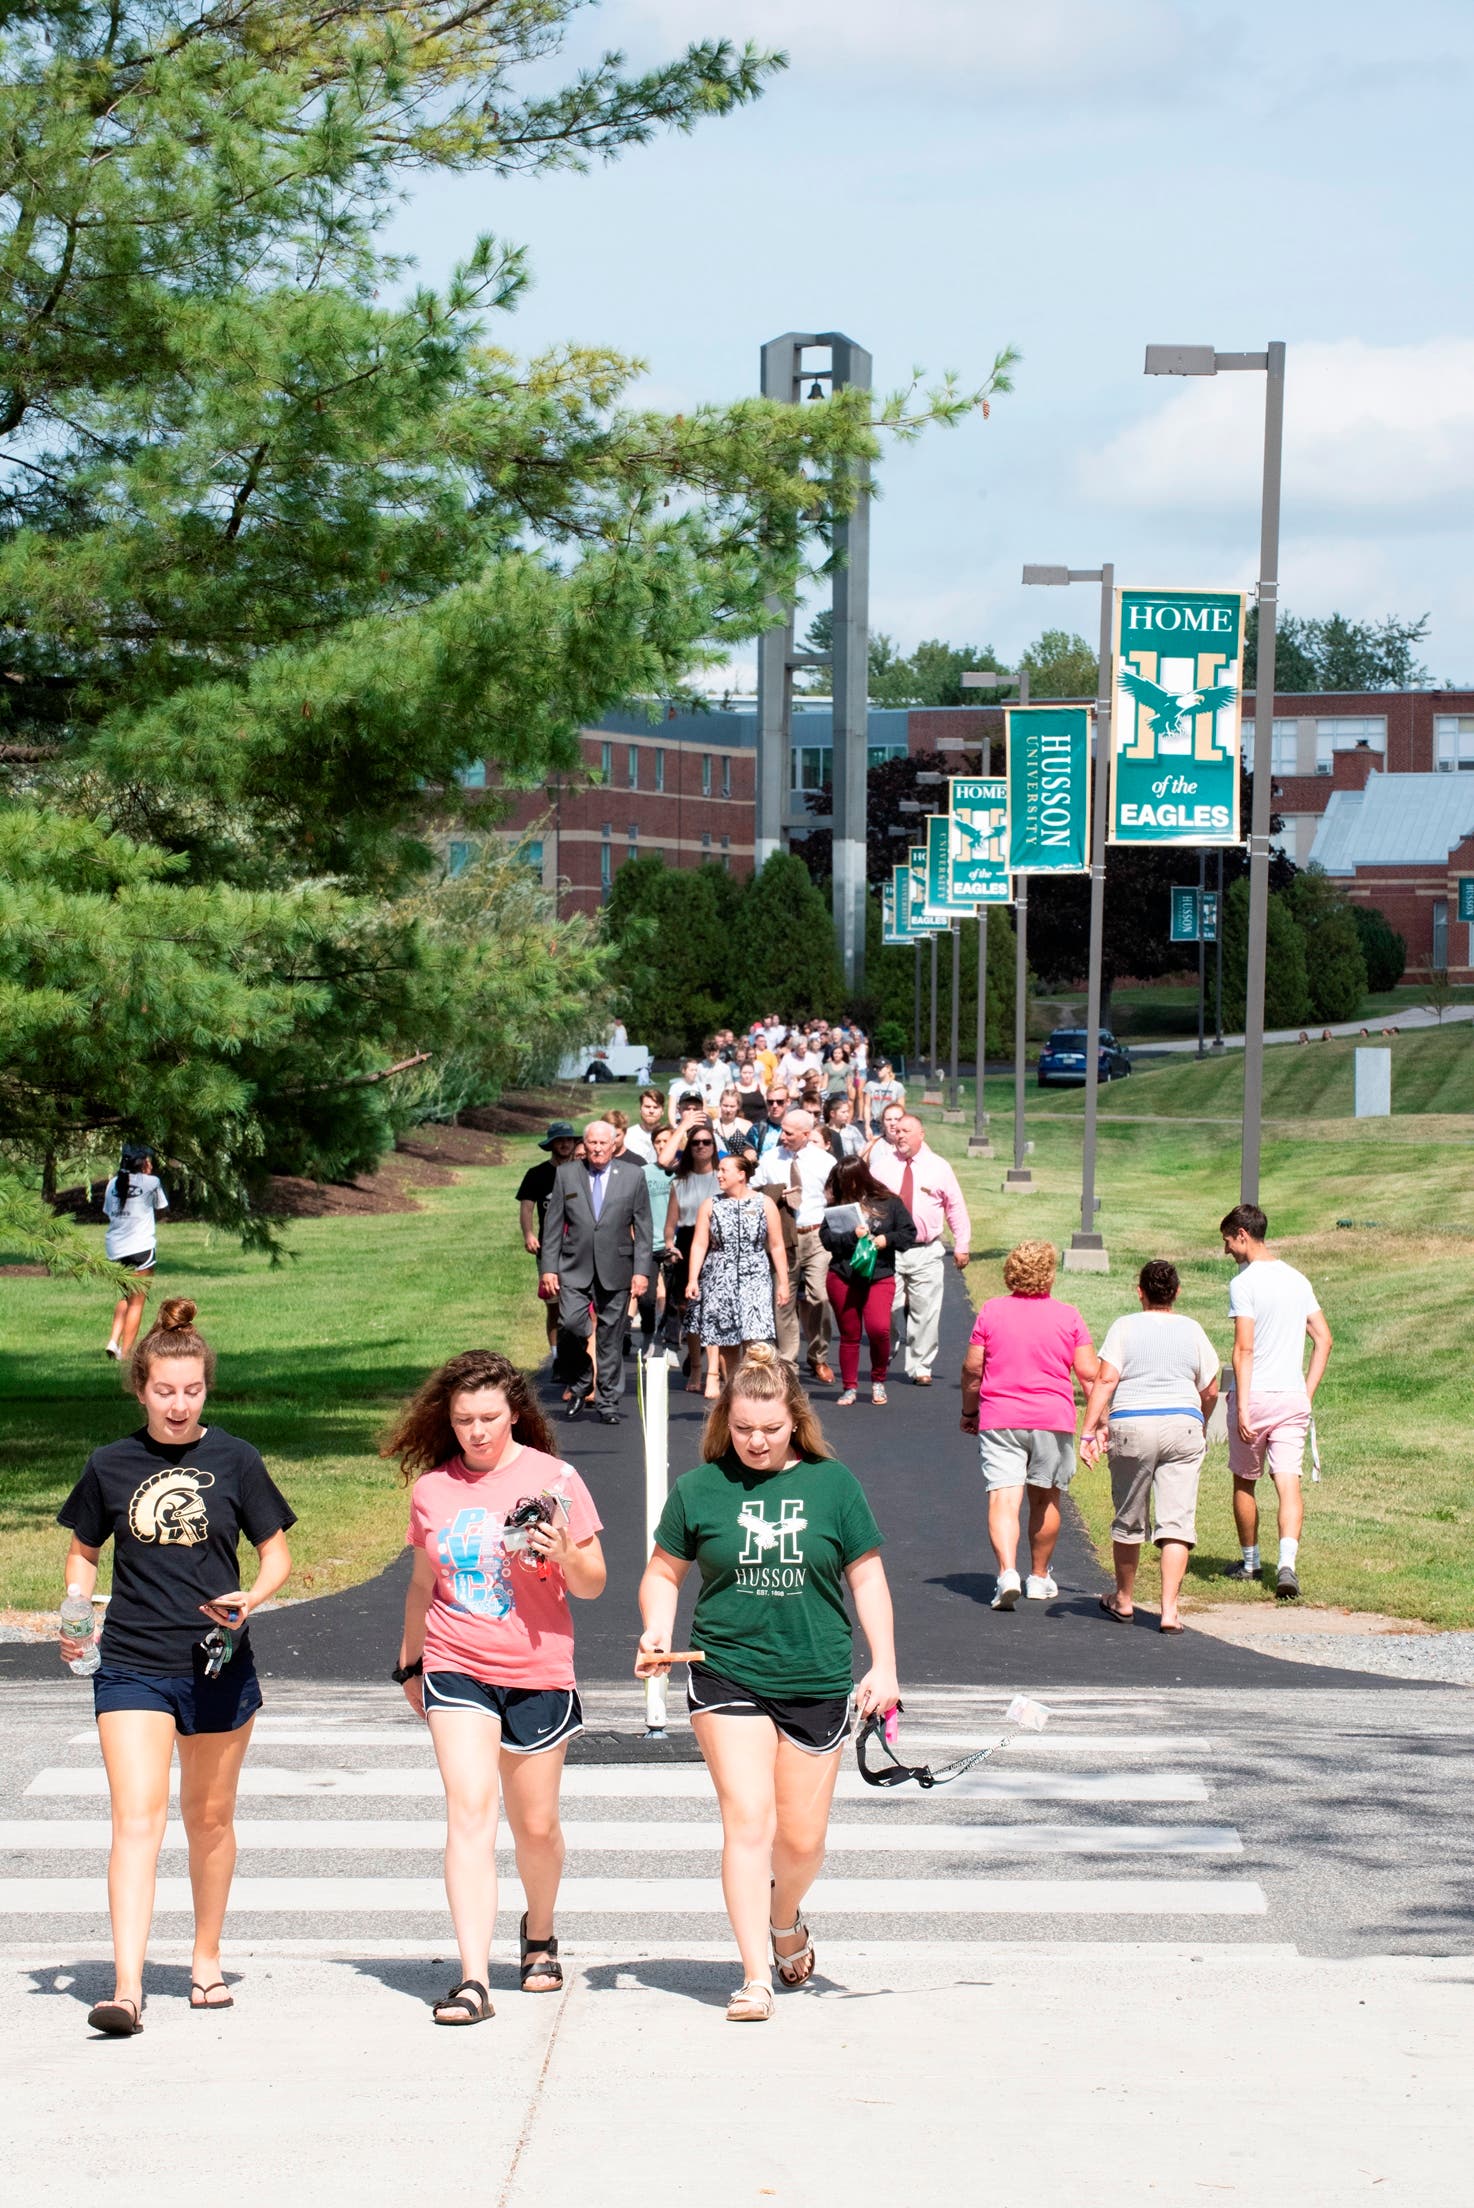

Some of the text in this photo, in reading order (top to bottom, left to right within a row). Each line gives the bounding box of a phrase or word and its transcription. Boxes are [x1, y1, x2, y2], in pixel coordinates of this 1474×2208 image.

[1129, 606, 1233, 632] HOME
[956, 786, 1007, 799] HOME
[1026, 735, 1039, 847] UNIVERSITY
[1041, 734, 1071, 848] HUSSON
[1151, 775, 1198, 798] of the
[1120, 803, 1229, 827] EAGLES
[937, 832, 947, 899] UNIVERSITY
[968, 868, 992, 879] of the
[953, 882, 1008, 895] EAGLES
[911, 916, 947, 925] EAGLES
[1182, 896, 1193, 933] HUSSON
[735, 1567, 807, 1589] HUSSON
